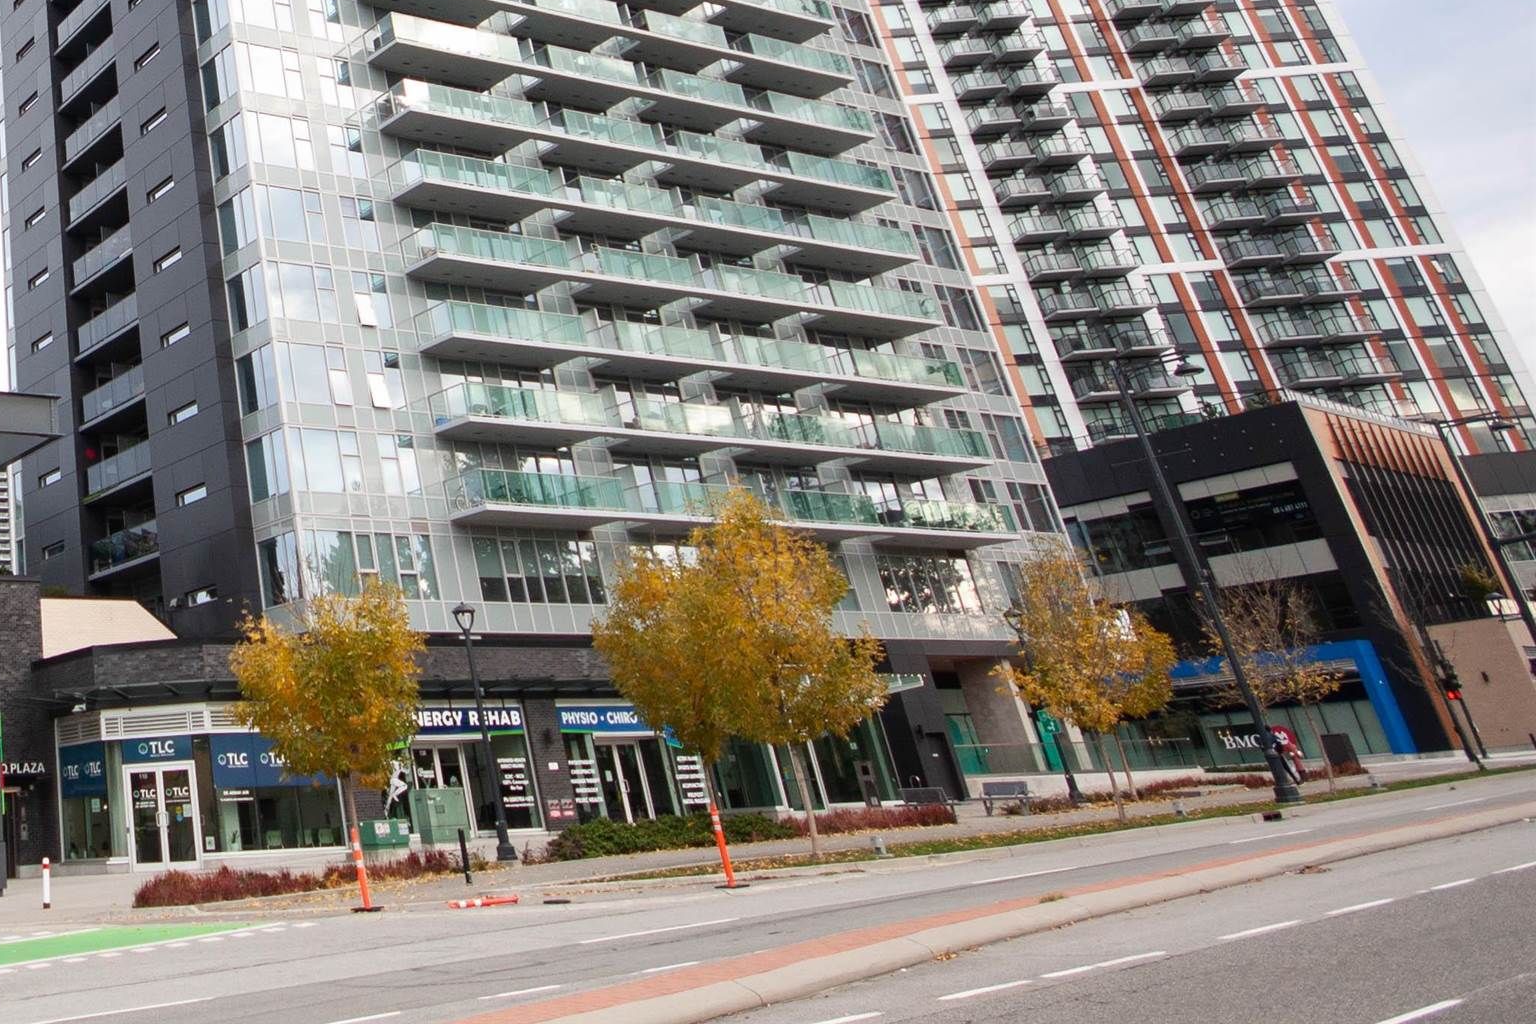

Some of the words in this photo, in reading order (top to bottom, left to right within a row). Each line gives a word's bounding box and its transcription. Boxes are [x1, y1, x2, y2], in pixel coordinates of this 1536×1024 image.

[561, 711, 598, 725] PHYSIO
[149, 740, 175, 755] TLC
[226, 752, 248, 766] TLC
[10, 761, 46, 775] PLAZA
[67, 764, 80, 776] TLC
[89, 761, 102, 774] TLC
[140, 788, 156, 799] TLC
[172, 786, 189, 797] TLC
